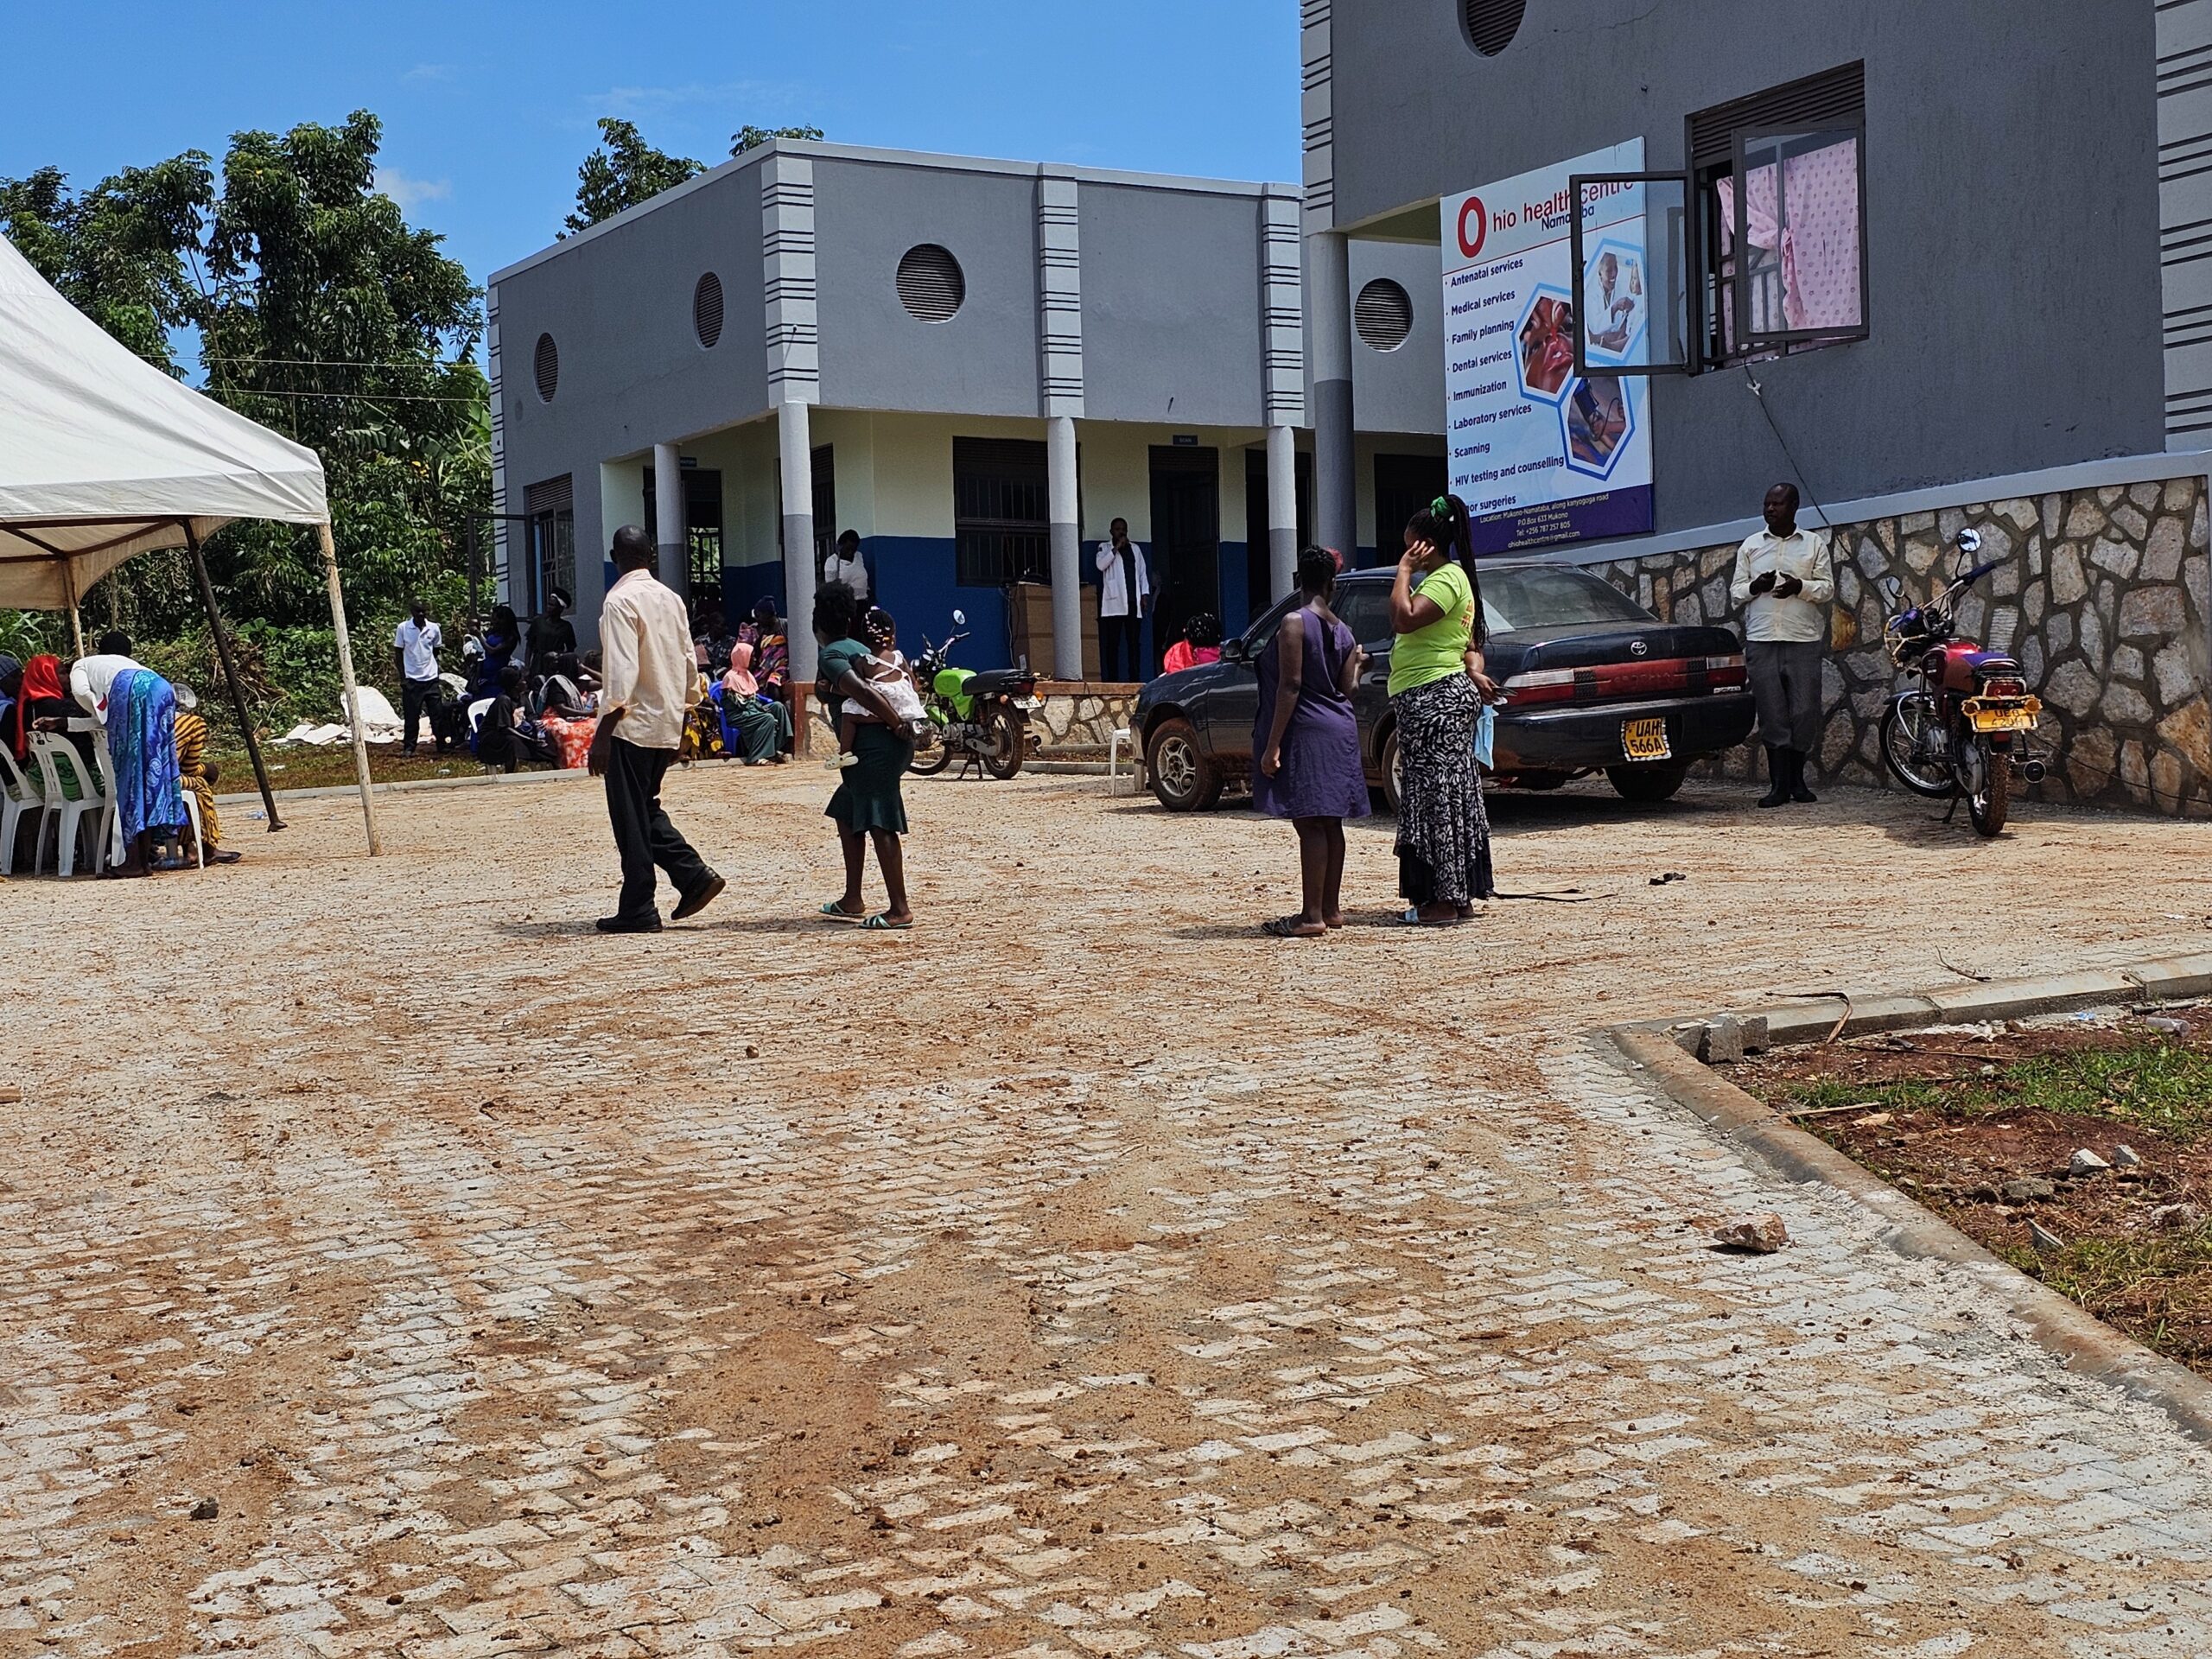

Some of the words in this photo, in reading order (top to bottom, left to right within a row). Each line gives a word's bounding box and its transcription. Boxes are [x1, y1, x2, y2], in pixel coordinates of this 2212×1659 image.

[1524, 189, 1571, 223] health
[1541, 206, 1594, 231] Namaba
[1451, 267, 1489, 288] Antenatal
[1491, 259, 1523, 276] services
[1452, 298, 1480, 315] Medical
[1483, 290, 1516, 307] services
[1452, 329, 1478, 344] Family
[1479, 321, 1515, 339] planning
[1452, 357, 1478, 372] Dental
[1479, 350, 1512, 366] services
[1453, 381, 1507, 401] Immunization
[1453, 412, 1497, 429] Laboratory
[1498, 404, 1532, 420] services
[1454, 442, 1491, 458] Scanning
[1455, 474, 1470, 486] HIV
[1471, 469, 1498, 483] testing
[1500, 464, 1516, 478] and
[1518, 456, 1564, 473] counselling
[1480, 494, 1516, 510] surgeries
[1596, 493, 1609, 501] road
[1548, 512, 1568, 521] Mukono
[1636, 720, 1660, 737] UAH
[1630, 737, 1663, 753] 566A
